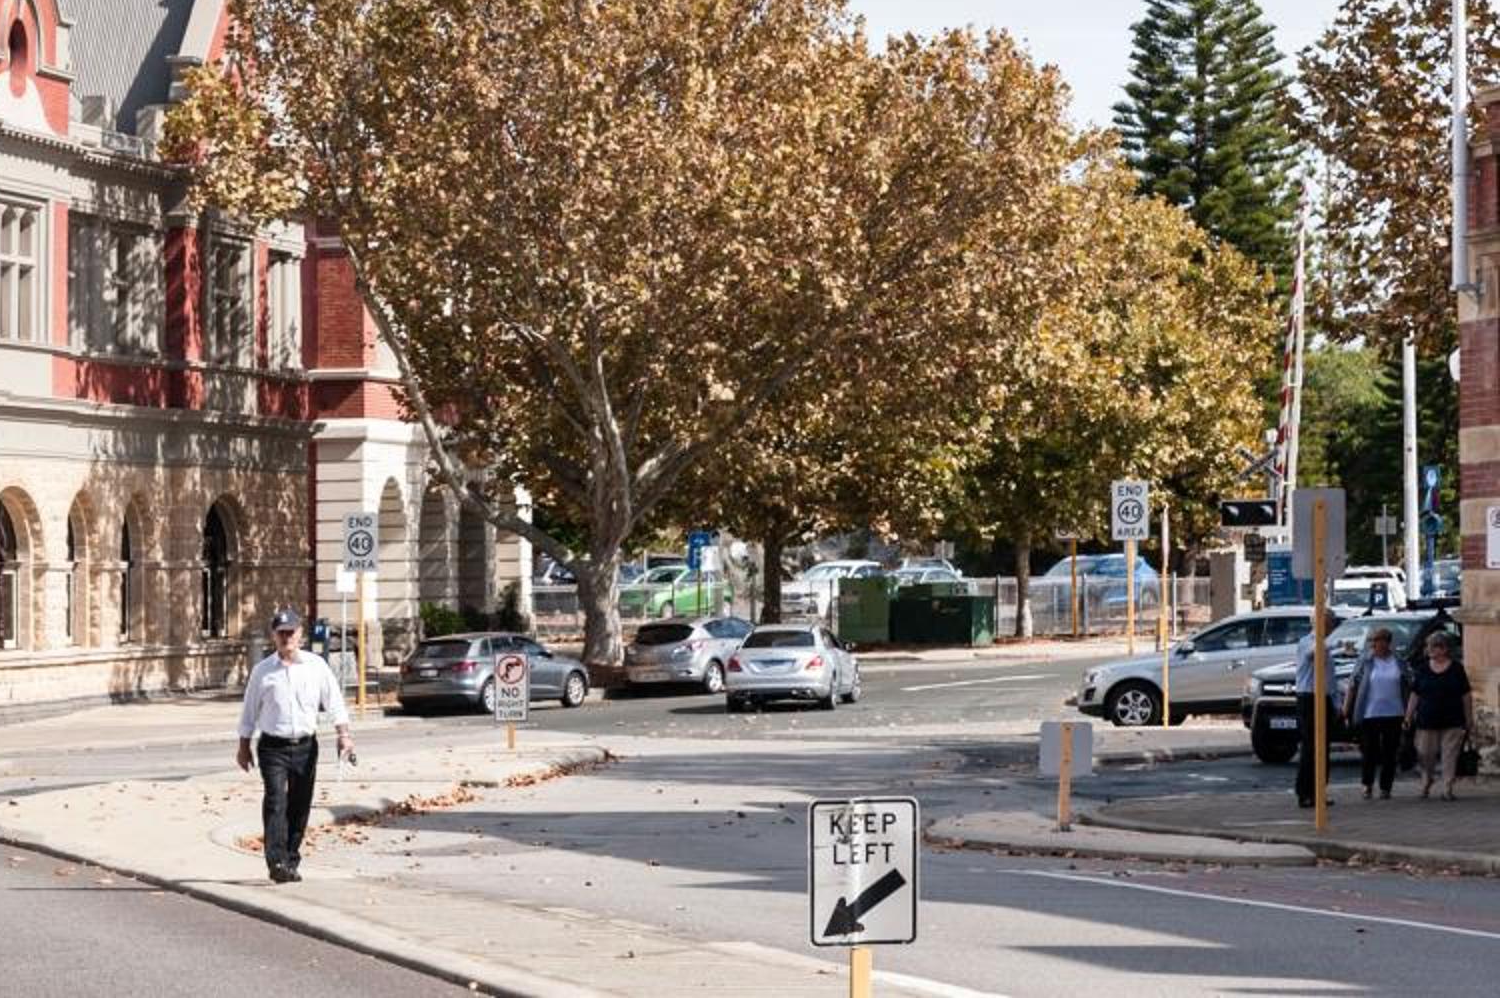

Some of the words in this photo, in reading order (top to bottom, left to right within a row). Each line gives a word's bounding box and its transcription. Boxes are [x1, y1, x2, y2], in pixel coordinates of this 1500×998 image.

[1117, 485, 1143, 497] END
[1121, 505, 1141, 519] 40
[348, 516, 373, 528] END
[1117, 527, 1144, 537] AREA
[351, 537, 373, 551] 40
[347, 559, 375, 569] AREA
[501, 687, 520, 699] NO
[829, 812, 897, 834] KEEP
[833, 843, 894, 865] LEFT
